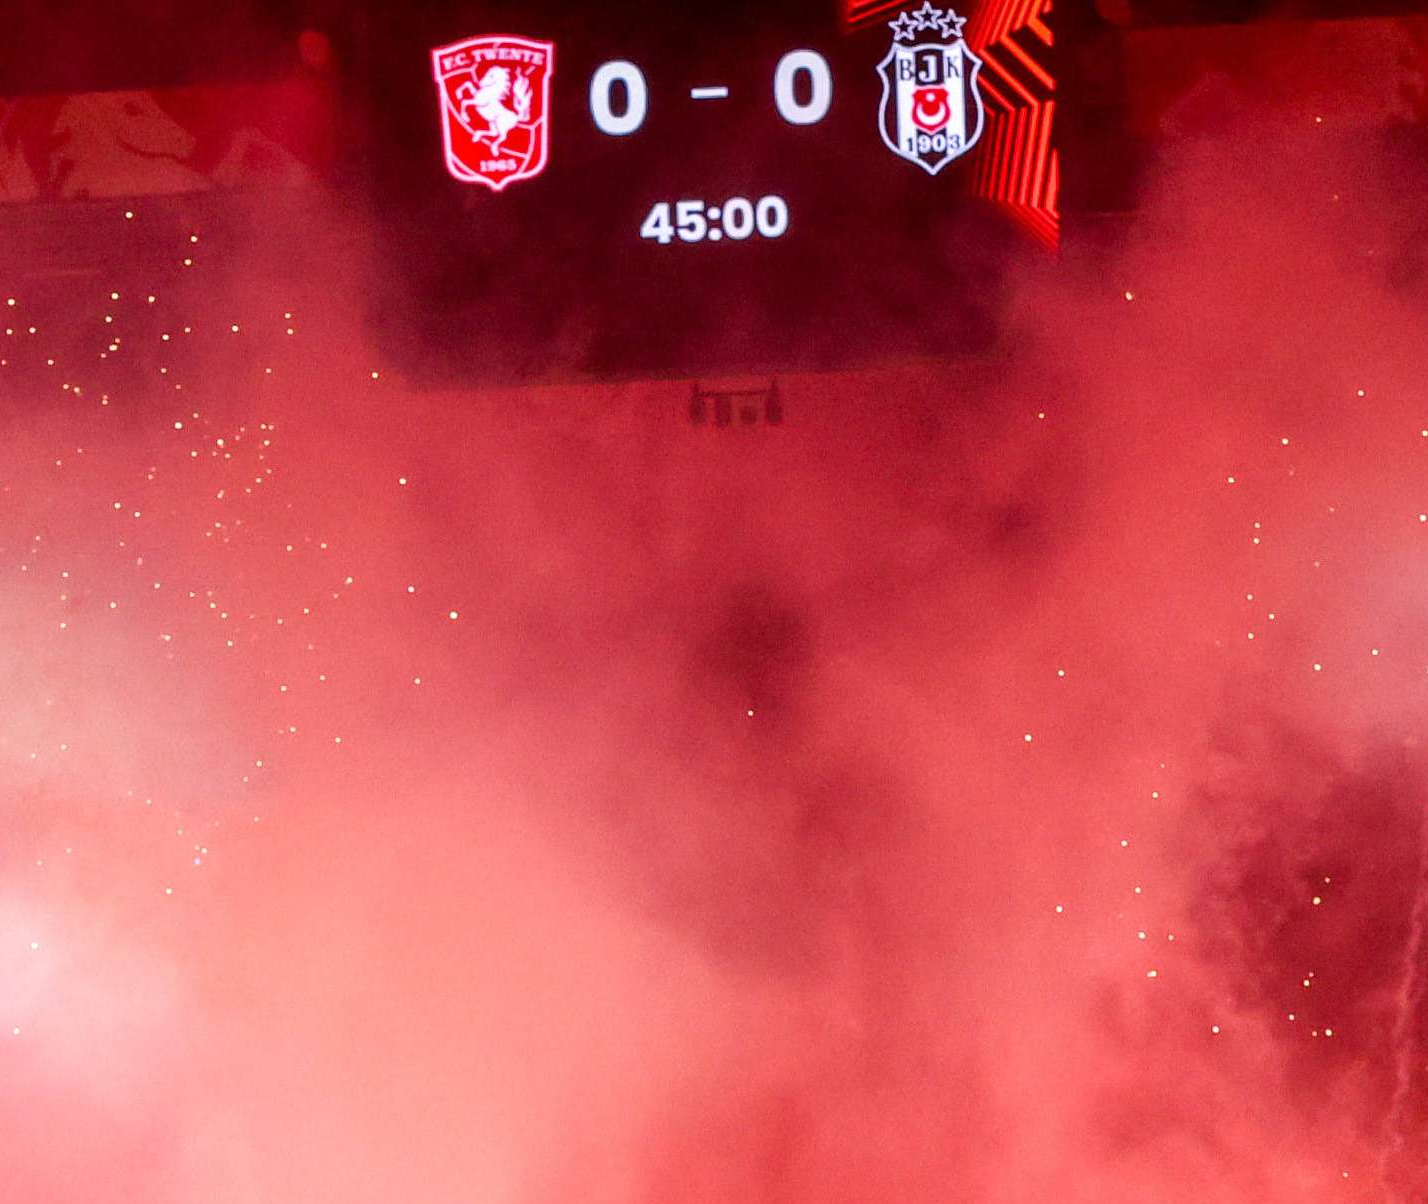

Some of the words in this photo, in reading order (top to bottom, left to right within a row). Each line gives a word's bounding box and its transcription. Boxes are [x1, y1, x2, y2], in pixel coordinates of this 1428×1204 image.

[471, 47, 545, 65] TWENTE
[899, 54, 960, 82] BJK
[589, 59, 648, 136] 0
[773, 49, 833, 126] 0
[906, 133, 961, 152] 1903
[639, 194, 789, 244] 45:00
